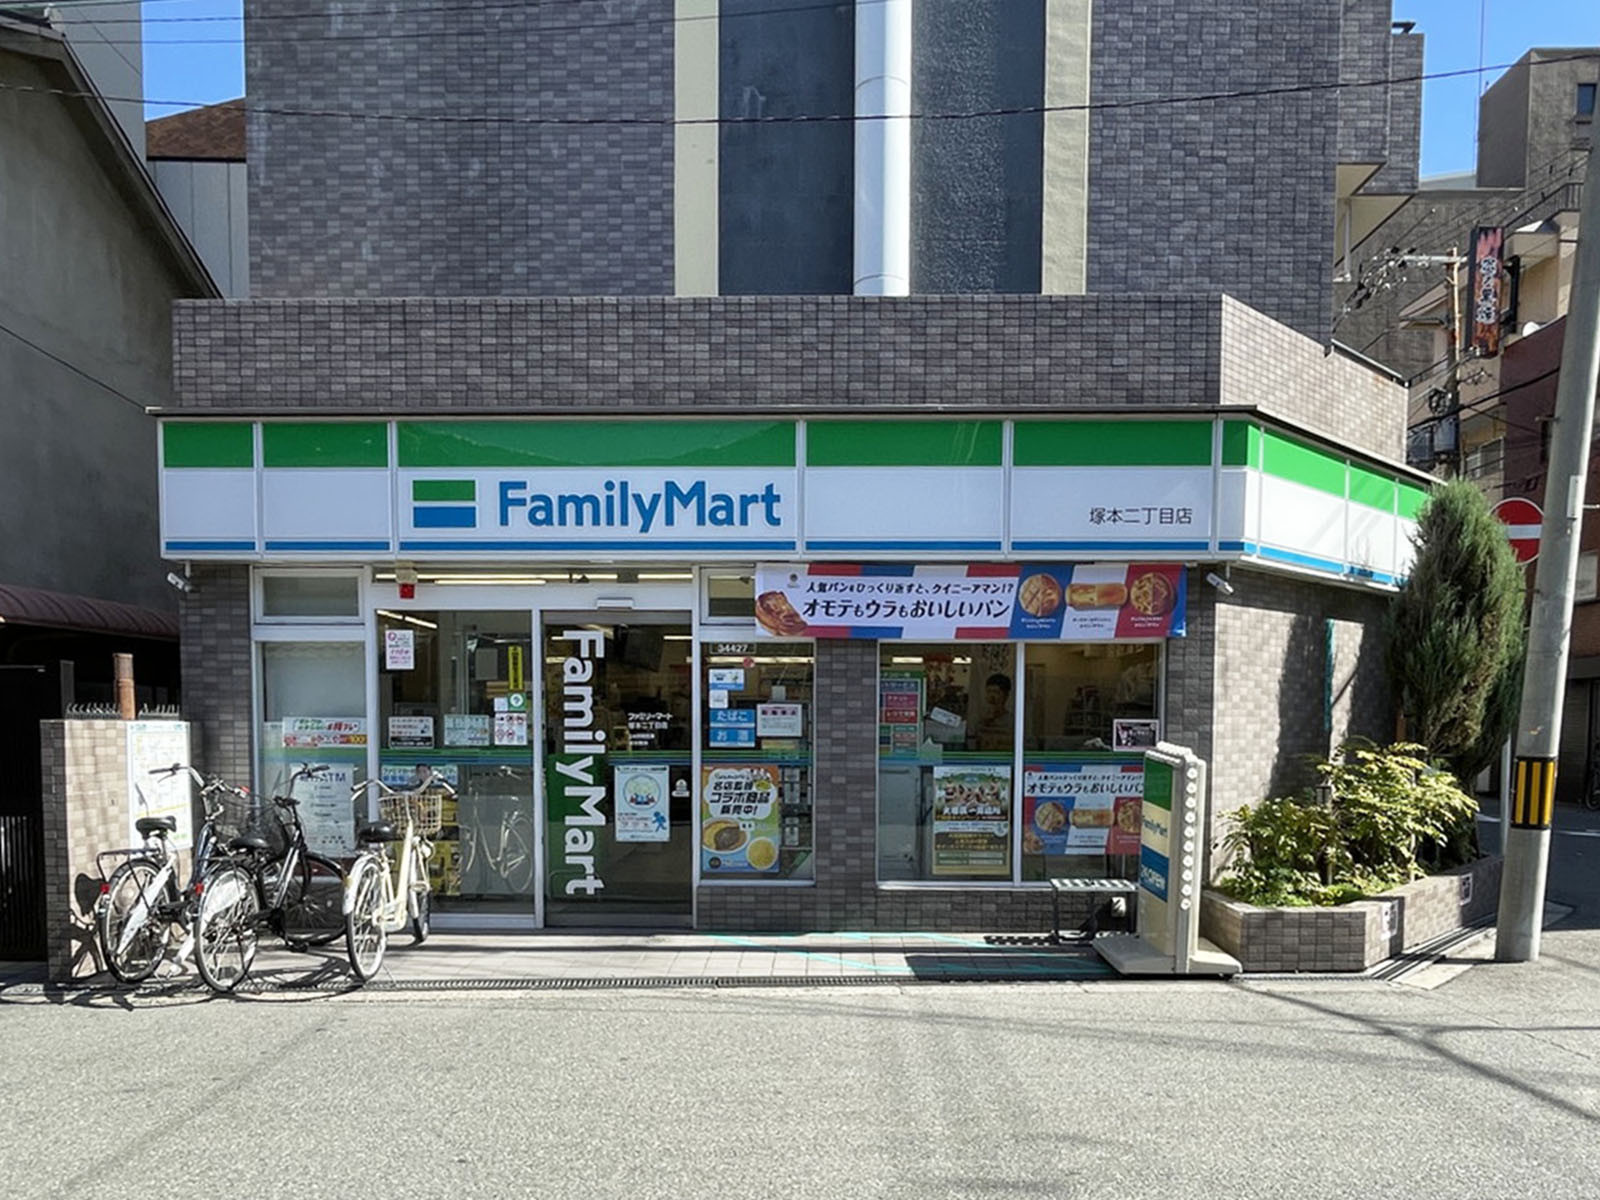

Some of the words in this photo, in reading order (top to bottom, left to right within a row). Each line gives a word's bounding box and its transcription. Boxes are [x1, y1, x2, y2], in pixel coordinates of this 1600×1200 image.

[499, 480, 781, 533] FamilyMart
[1089, 507, 1192, 525] 塚本二丁目店
[803, 600, 1011, 619] オモテもウラもおいしいパン
[717, 710, 748, 721] たばこ
[555, 630, 606, 895] FamilyMart
[710, 792, 771, 803] コラボ商品
